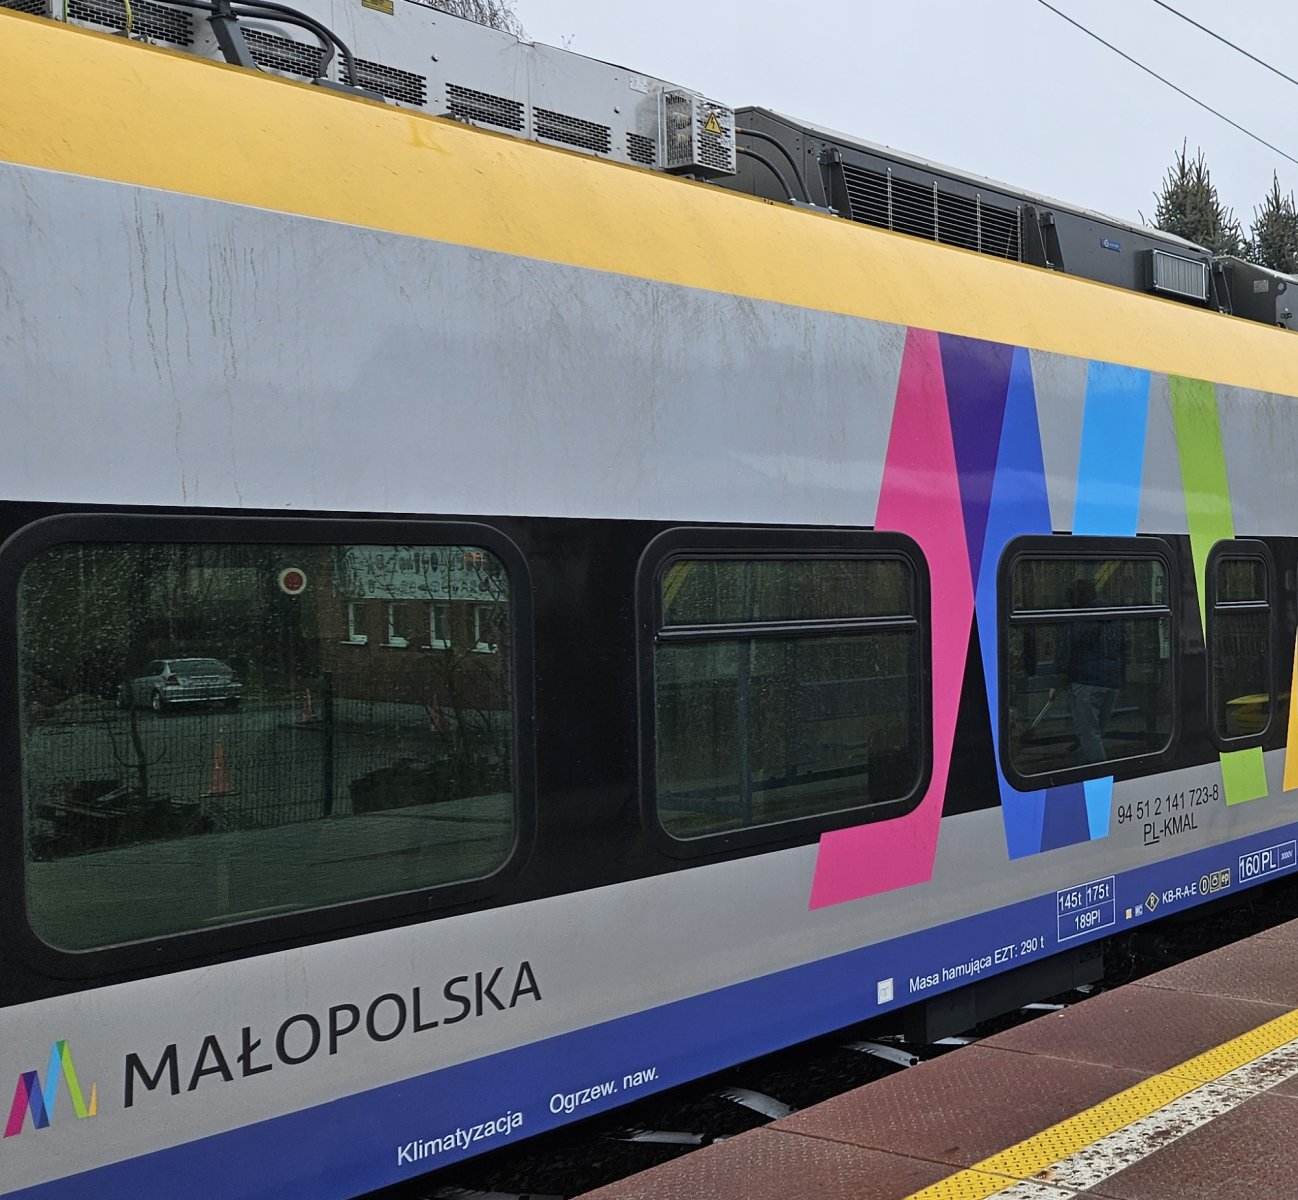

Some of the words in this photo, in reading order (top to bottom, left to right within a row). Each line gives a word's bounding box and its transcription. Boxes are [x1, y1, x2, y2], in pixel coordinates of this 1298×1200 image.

[1117, 803, 1133, 825] 94
[1136, 800, 1150, 820] 51
[1154, 797, 1162, 815] 2
[1166, 792, 1185, 812] 141
[1189, 784, 1219, 807] 723-8
[1144, 812, 1198, 846] PL-KMAL
[1239, 855, 1259, 878] 160
[1261, 852, 1277, 871] PL
[1059, 891, 1082, 911] 145t
[1086, 883, 1109, 903] 175t
[1162, 883, 1197, 904] KB-R-A-E
[909, 973, 939, 992] Masa
[942, 955, 992, 981] hamująca
[994, 944, 1018, 964] EZT:
[1020, 937, 1038, 956] 290
[1040, 935, 1045, 949] t
[124, 959, 543, 1109] MAŁOPOLSKA
[549, 1082, 619, 1117] Ogrzew.
[623, 1066, 660, 1090] naw.
[396, 1109, 524, 1167] Klimatyzacja
